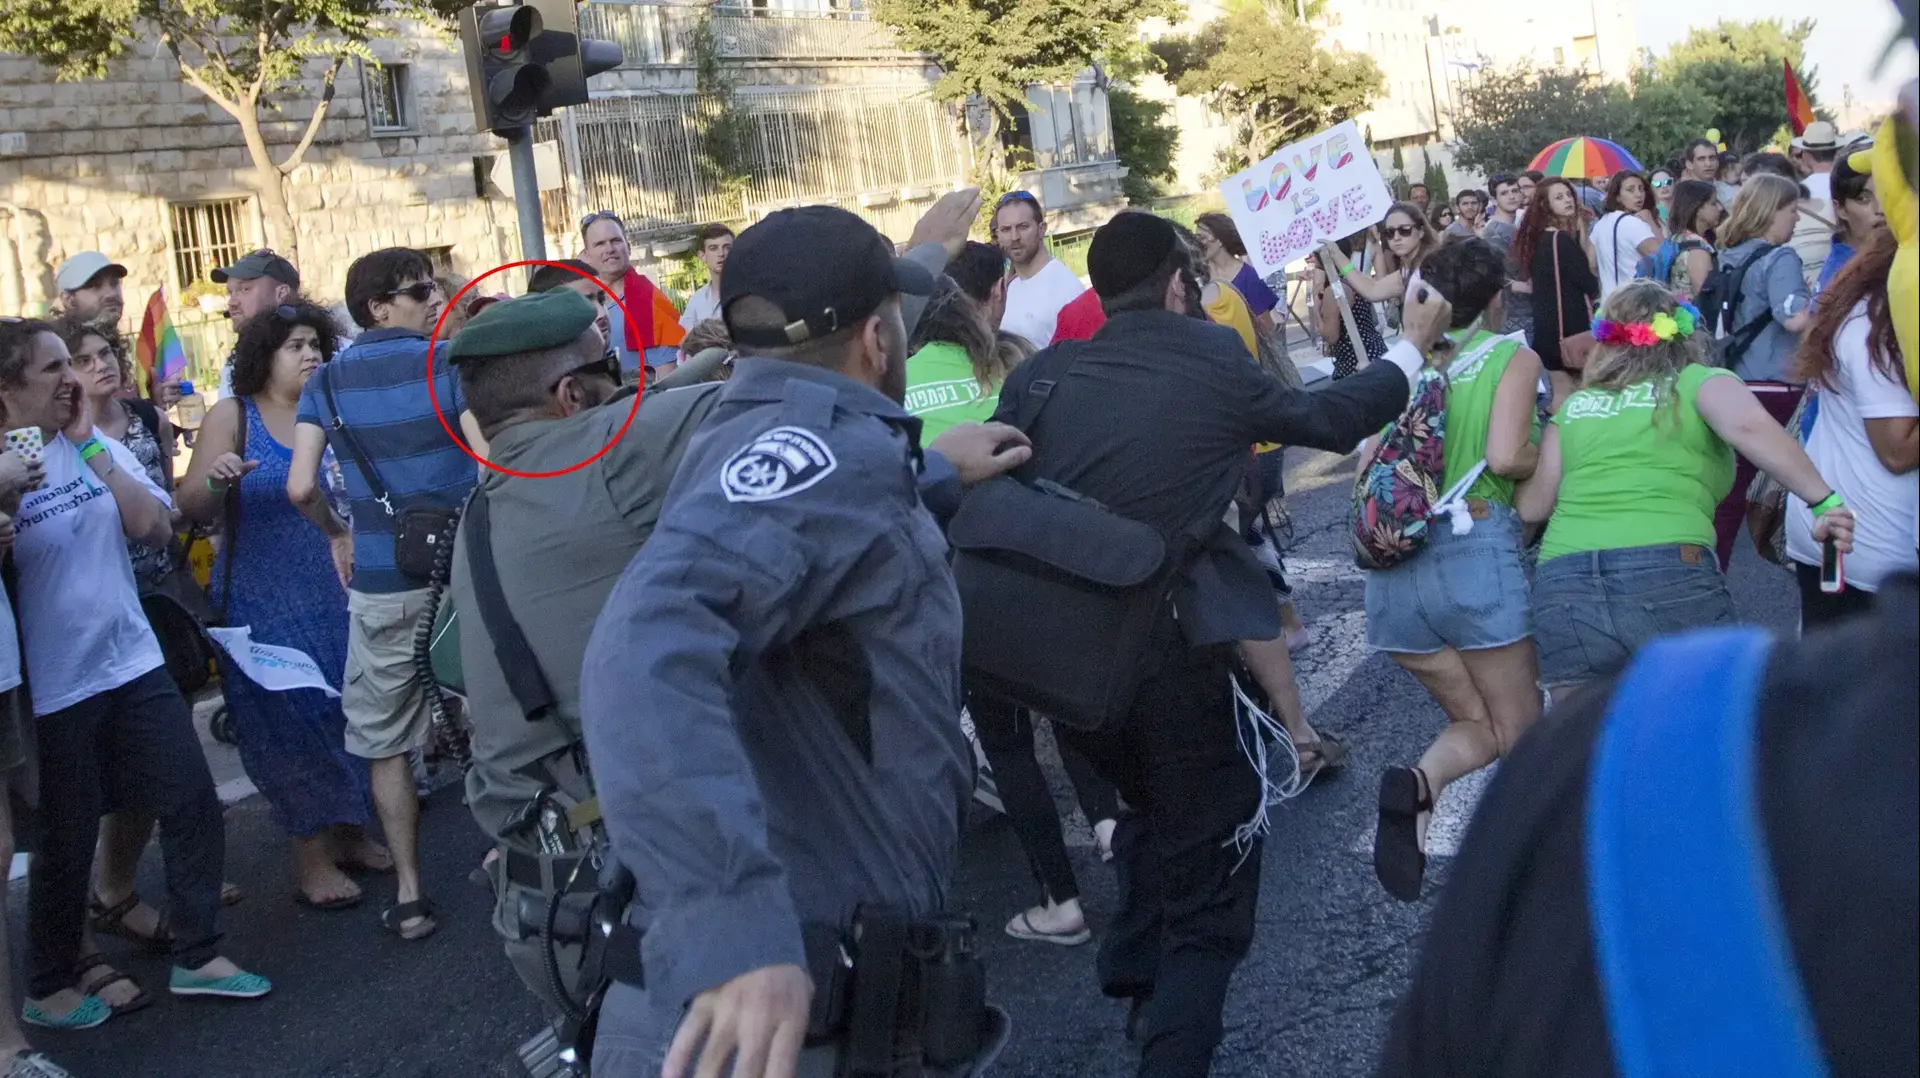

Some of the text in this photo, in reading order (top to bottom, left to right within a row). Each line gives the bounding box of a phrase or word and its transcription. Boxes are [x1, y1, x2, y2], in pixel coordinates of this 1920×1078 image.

[1242, 133, 1354, 212] LOVE
[1291, 186, 1320, 215] IS
[1259, 184, 1373, 265] LOVE
